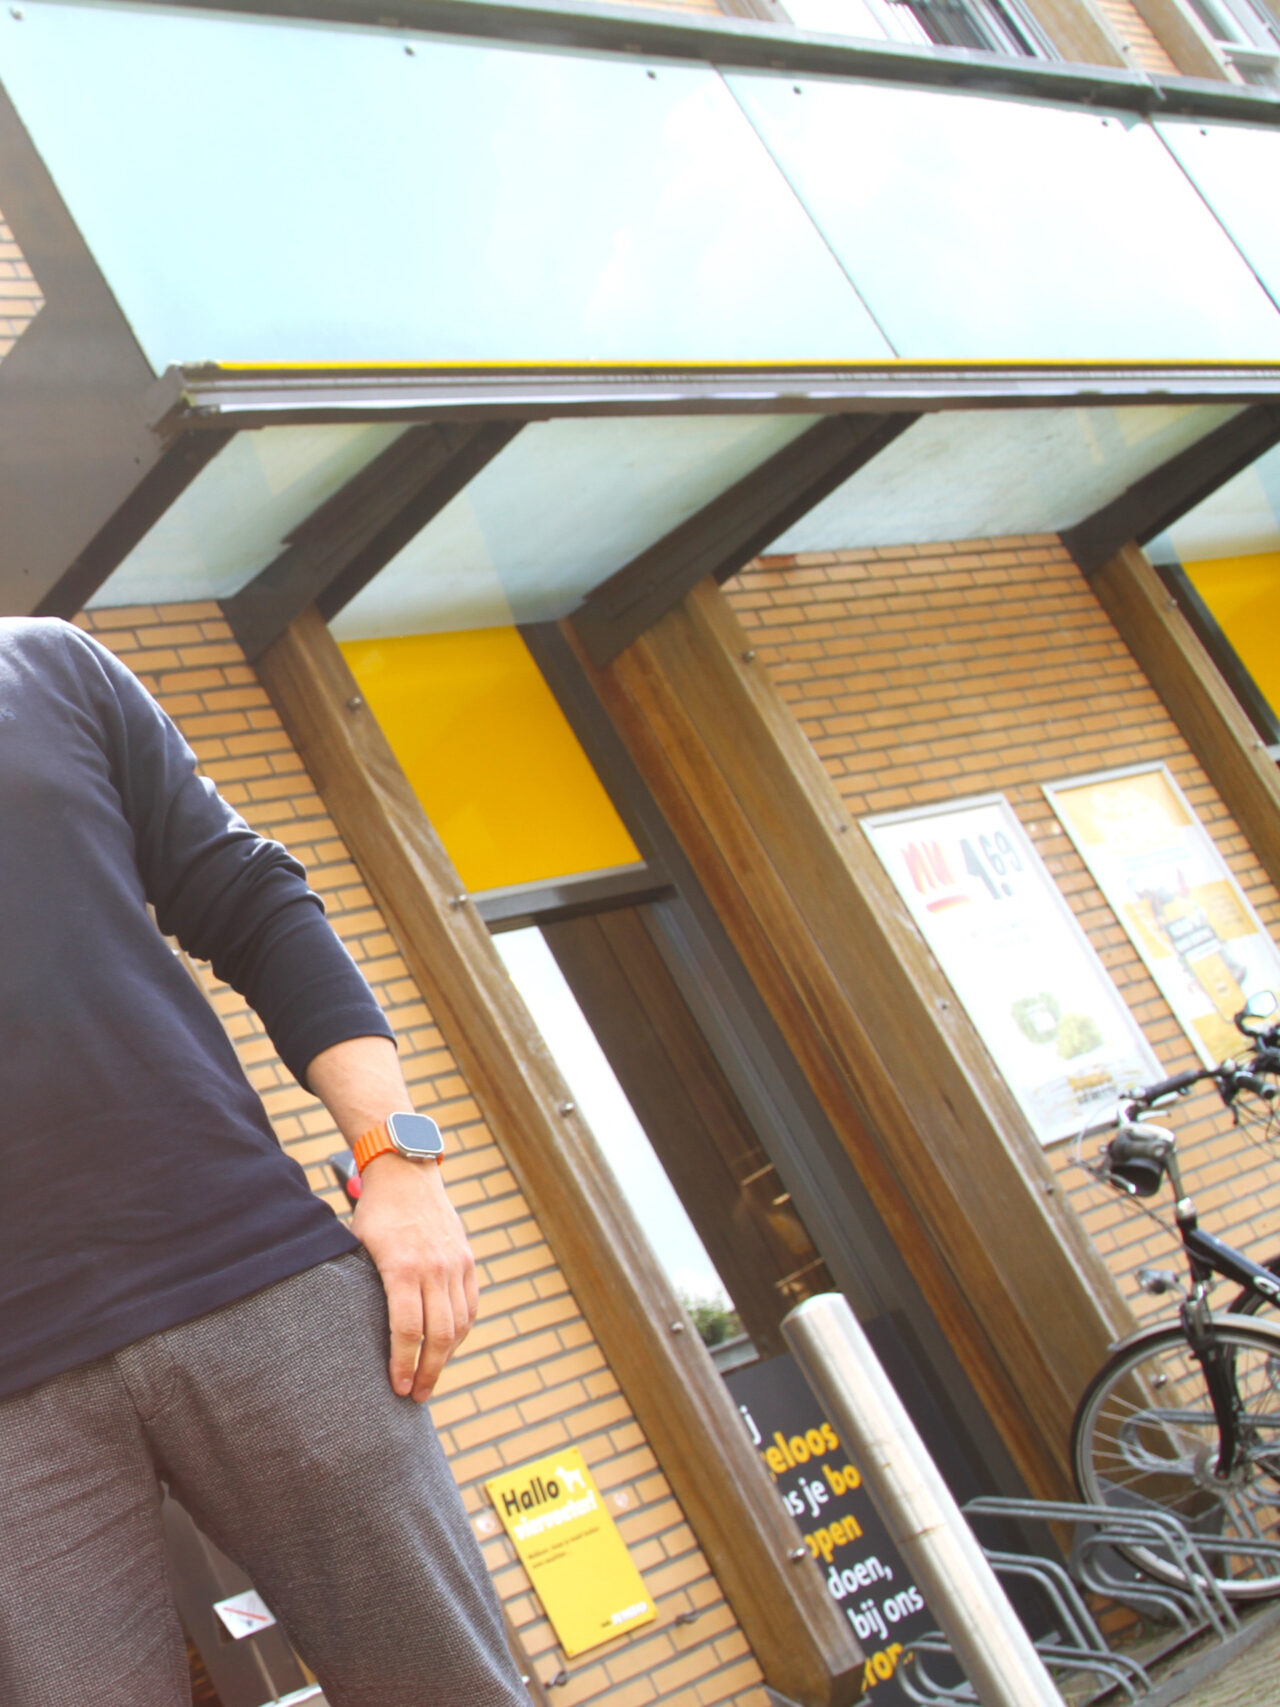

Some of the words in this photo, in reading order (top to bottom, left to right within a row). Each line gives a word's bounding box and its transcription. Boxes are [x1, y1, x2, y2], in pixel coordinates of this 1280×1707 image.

[760, 1422, 840, 1484] eloos
[501, 1475, 560, 1518] Hallo
[798, 1476, 830, 1518] je
[821, 1463, 862, 1497] bo
[827, 1555, 894, 1601] doen,
[847, 1597, 889, 1640] bij
[883, 1585, 925, 1624] ons
